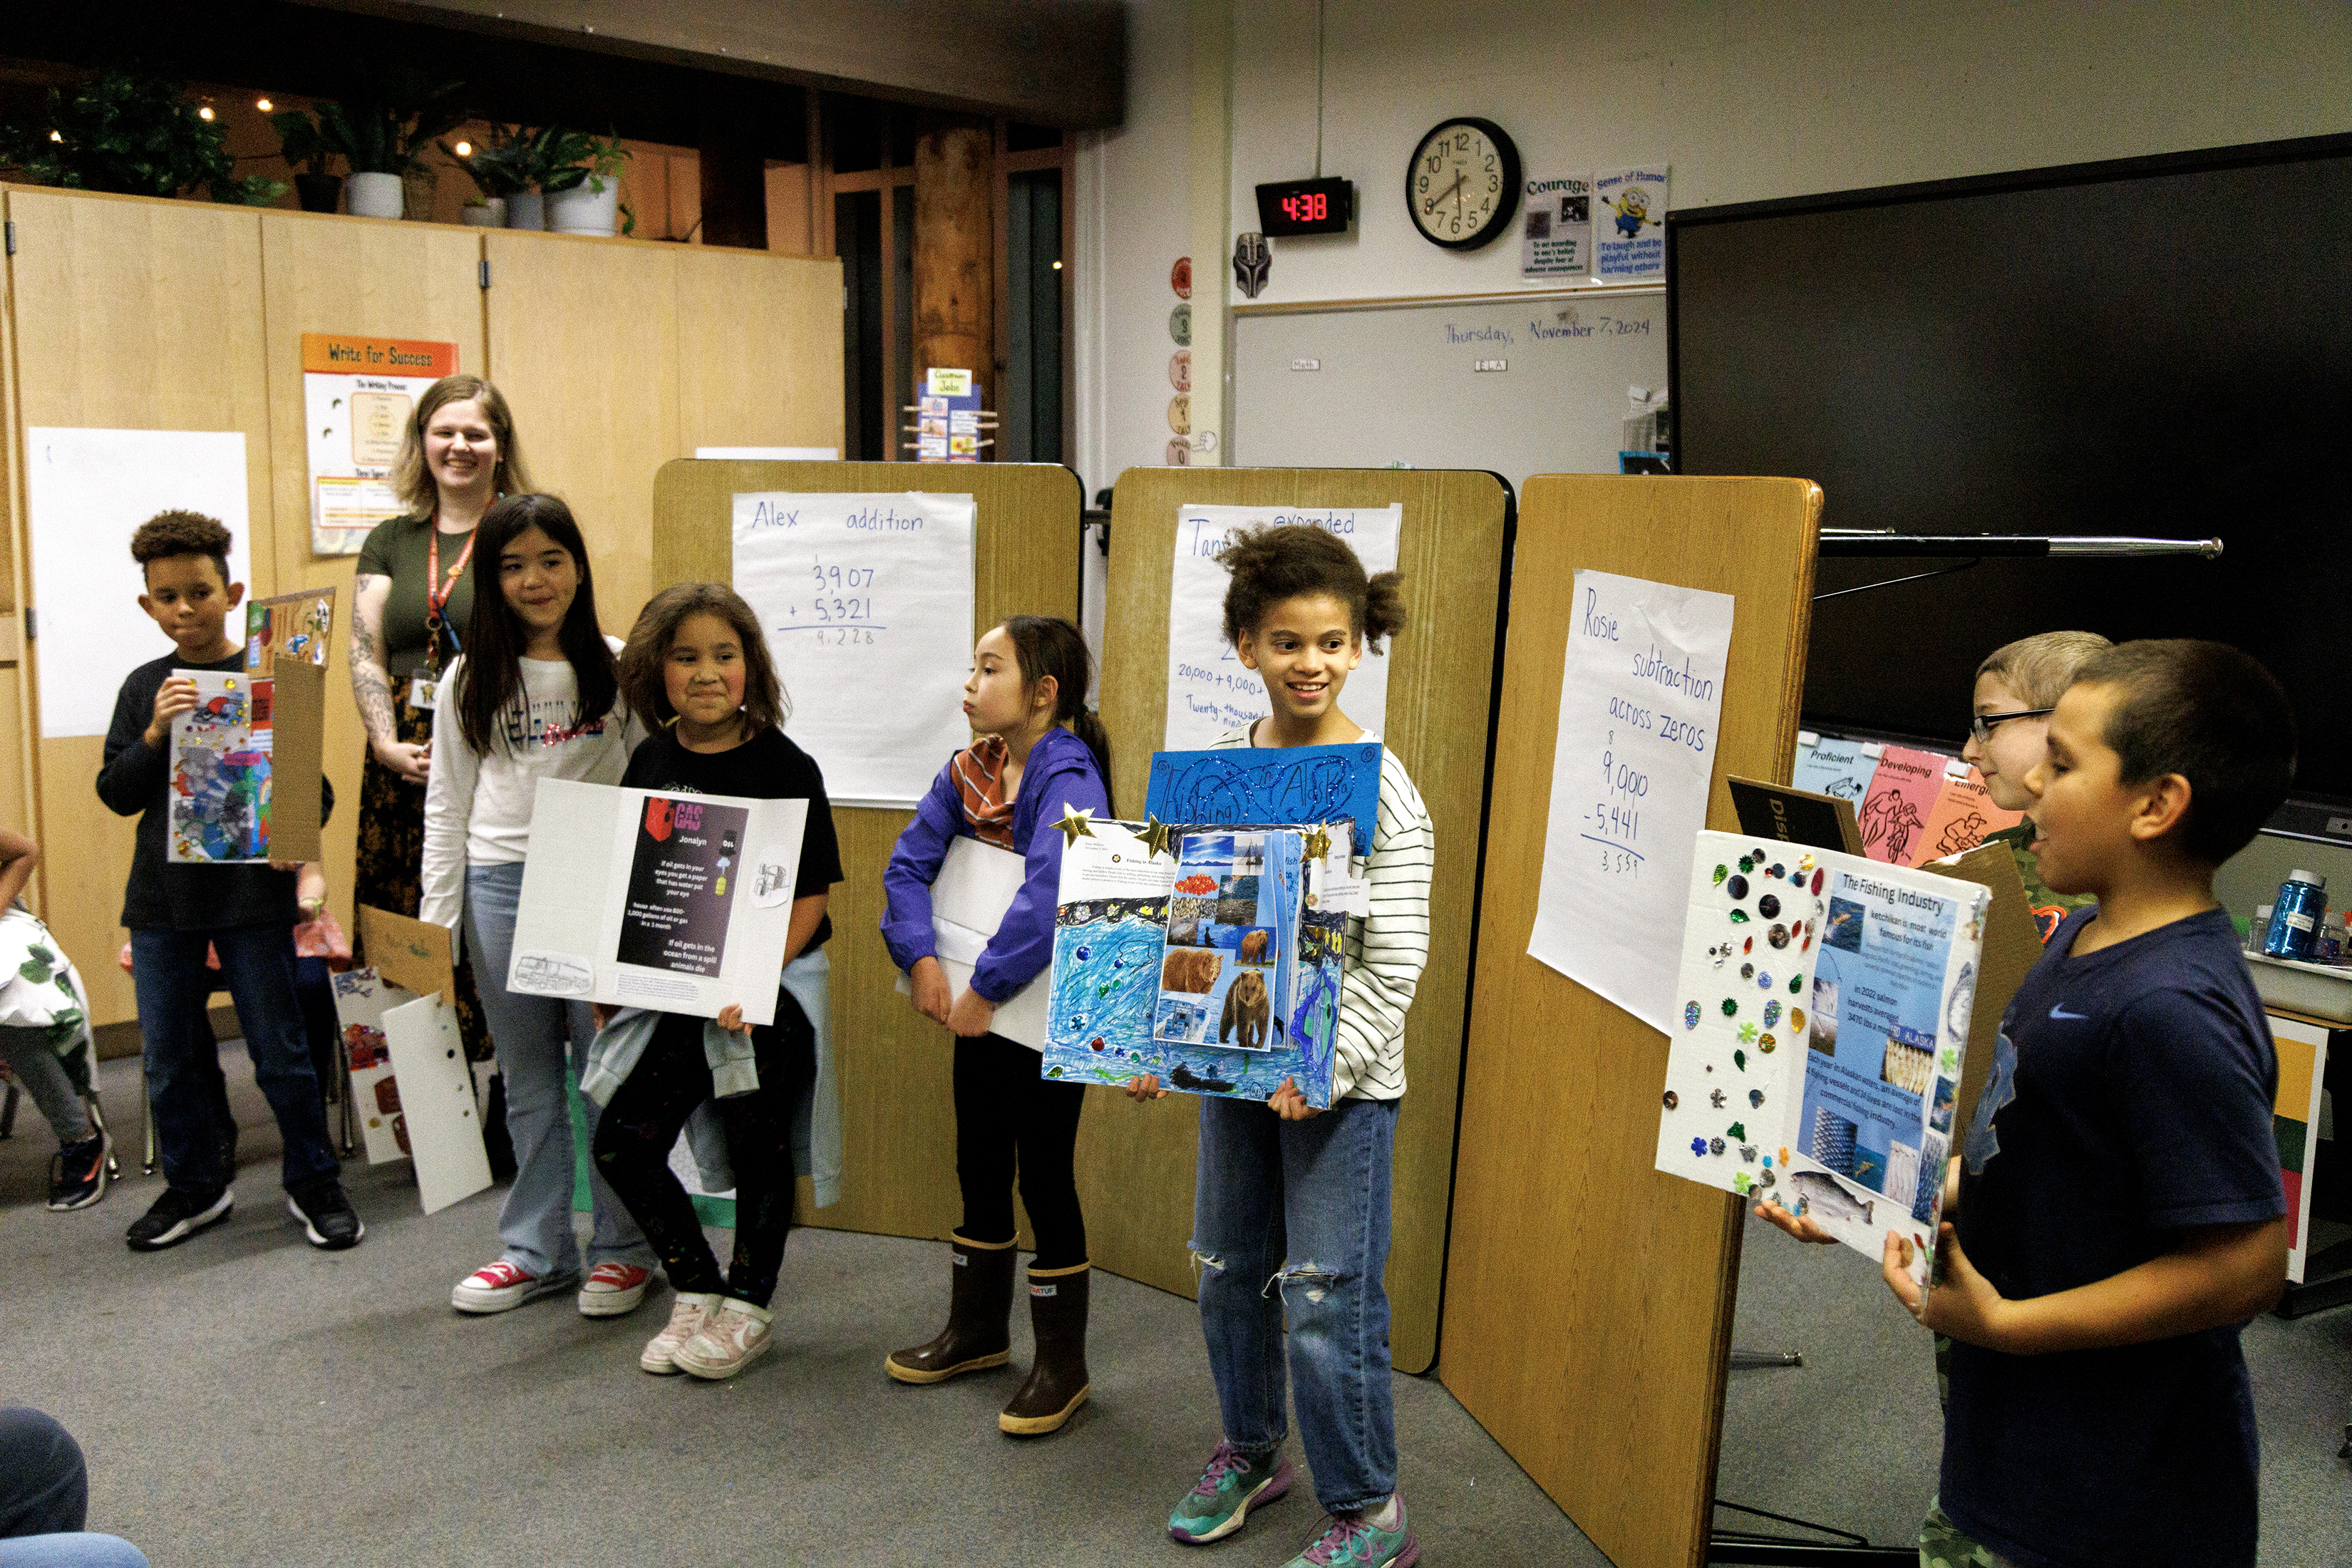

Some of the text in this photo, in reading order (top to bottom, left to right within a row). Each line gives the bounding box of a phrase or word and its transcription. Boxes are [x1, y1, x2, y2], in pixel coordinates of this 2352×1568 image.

[1438, 140, 1450, 157] 11
[1454, 133, 1470, 151] 12
[1476, 140, 1481, 156] 1
[1426, 155, 1441, 174] 10
[1485, 155, 1495, 172] 2
[1419, 176, 1429, 194] 9
[1488, 174, 1497, 193] 3
[1527, 180, 1589, 195] Courage
[1597, 171, 1666, 190] Sense of Humor
[1282, 193, 1327, 221] 4:38
[1425, 198, 1434, 215] 8
[1480, 197, 1490, 213] 4
[1436, 211, 1446, 228] 7
[1451, 216, 1461, 234] 6
[1468, 211, 1477, 228] 5
[1612, 241, 1634, 252] laugh
[1636, 239, 1651, 248] and
[1601, 251, 1661, 264] playful without
[1601, 264, 1633, 274] harming
[1445, 316, 1651, 348] Thursday, November 7, 2024
[329, 344, 432, 366] Write for Success
[752, 502, 924, 531] Alex addition
[813, 564, 875, 595] 3,907
[815, 598, 871, 623] 5,321
[1584, 587, 1620, 641] Rosie
[817, 629, 875, 647] 9,228
[1179, 664, 1212, 681] 20,000
[1227, 675, 1256, 695] 9,000
[1632, 644, 1713, 702] subtraction
[1609, 696, 1705, 752] across zeros
[1810, 751, 1854, 765] Proficient
[1880, 758, 1932, 778] Developing
[1597, 803, 1639, 841] 5,441
[679, 835, 707, 847] Jonalyn
[1843, 874, 1944, 917] The Fishing Industry
[1879, 927, 1902, 942] famous
[1904, 934, 1913, 944] for
[1922, 940, 1934, 951] fish
[1910, 922, 1927, 932] most
[1929, 927, 1948, 939] world
